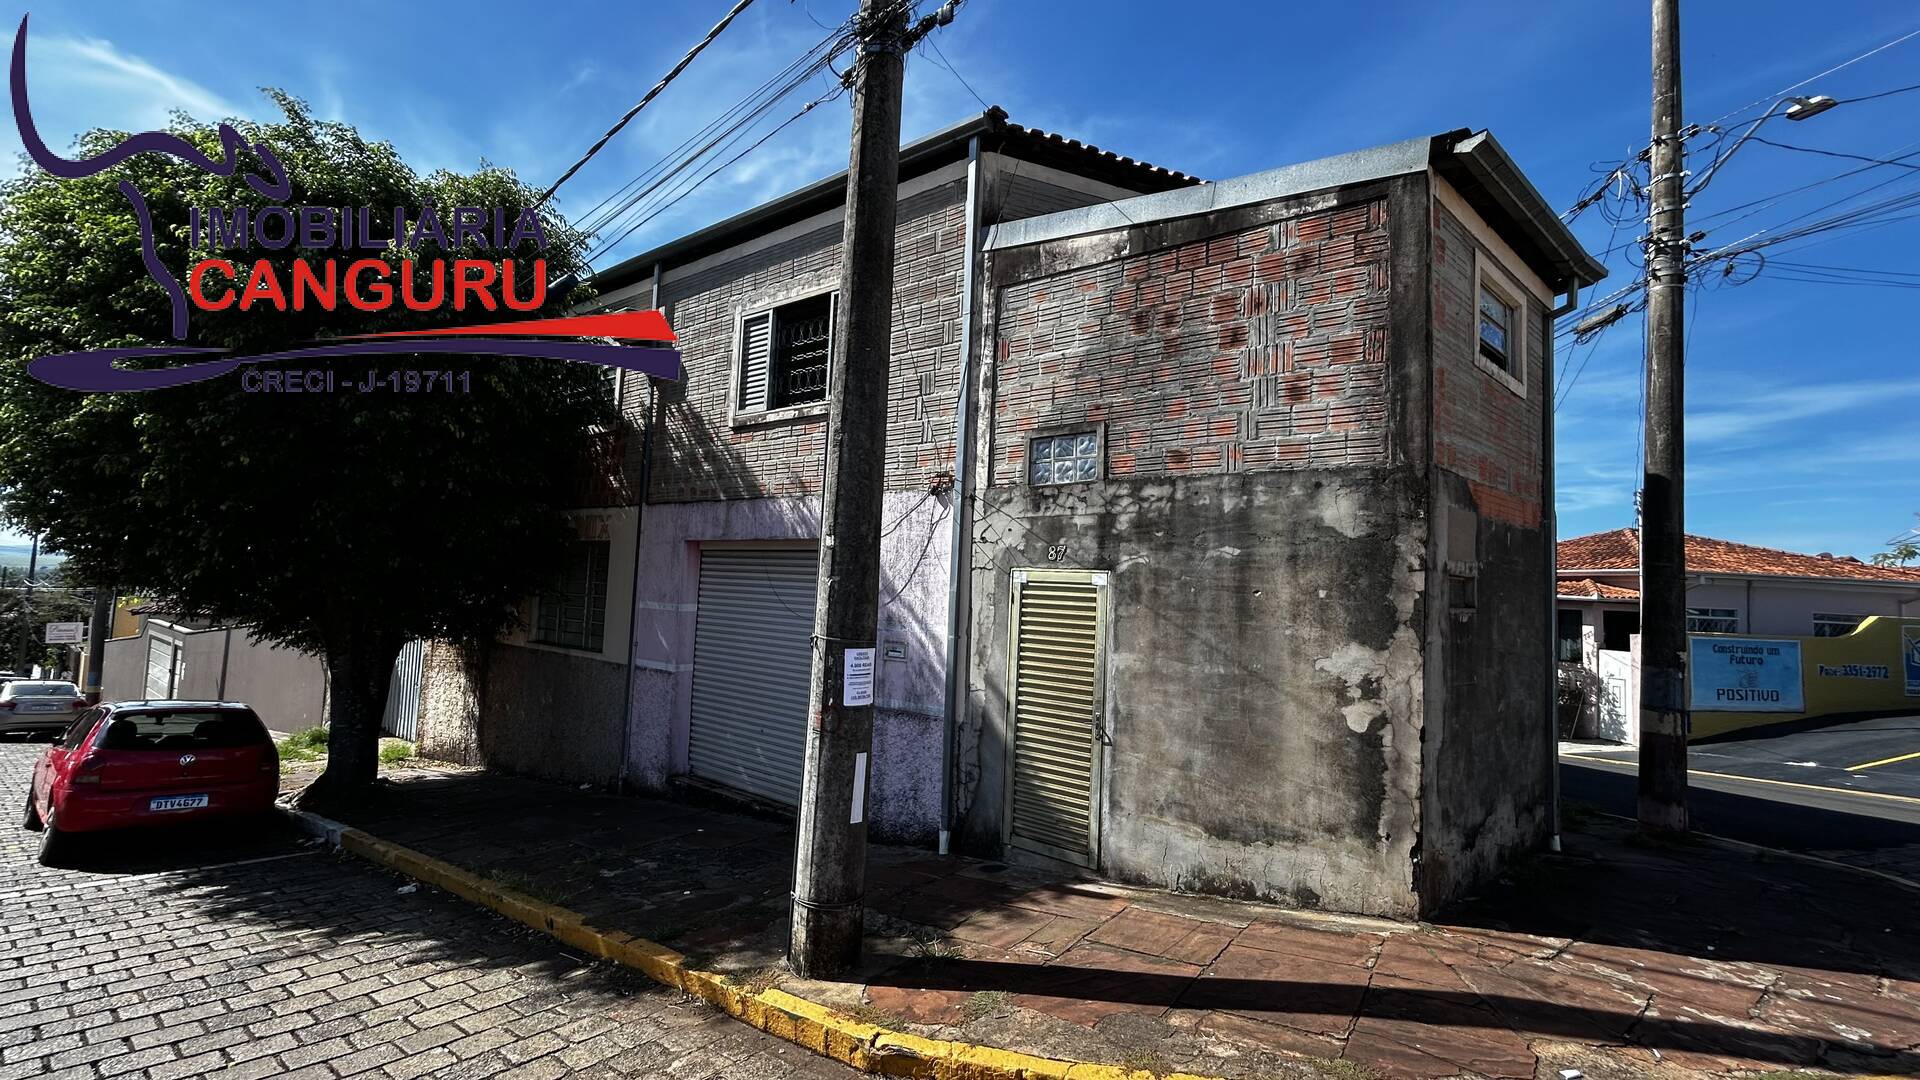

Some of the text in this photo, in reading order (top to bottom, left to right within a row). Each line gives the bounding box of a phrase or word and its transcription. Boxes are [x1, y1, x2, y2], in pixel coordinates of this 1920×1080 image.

[1048, 545, 1067, 562] 87
[1712, 644, 1780, 655] Construindo um
[1729, 655, 1764, 665] Futuro
[1716, 688, 1780, 702] POSITIVO
